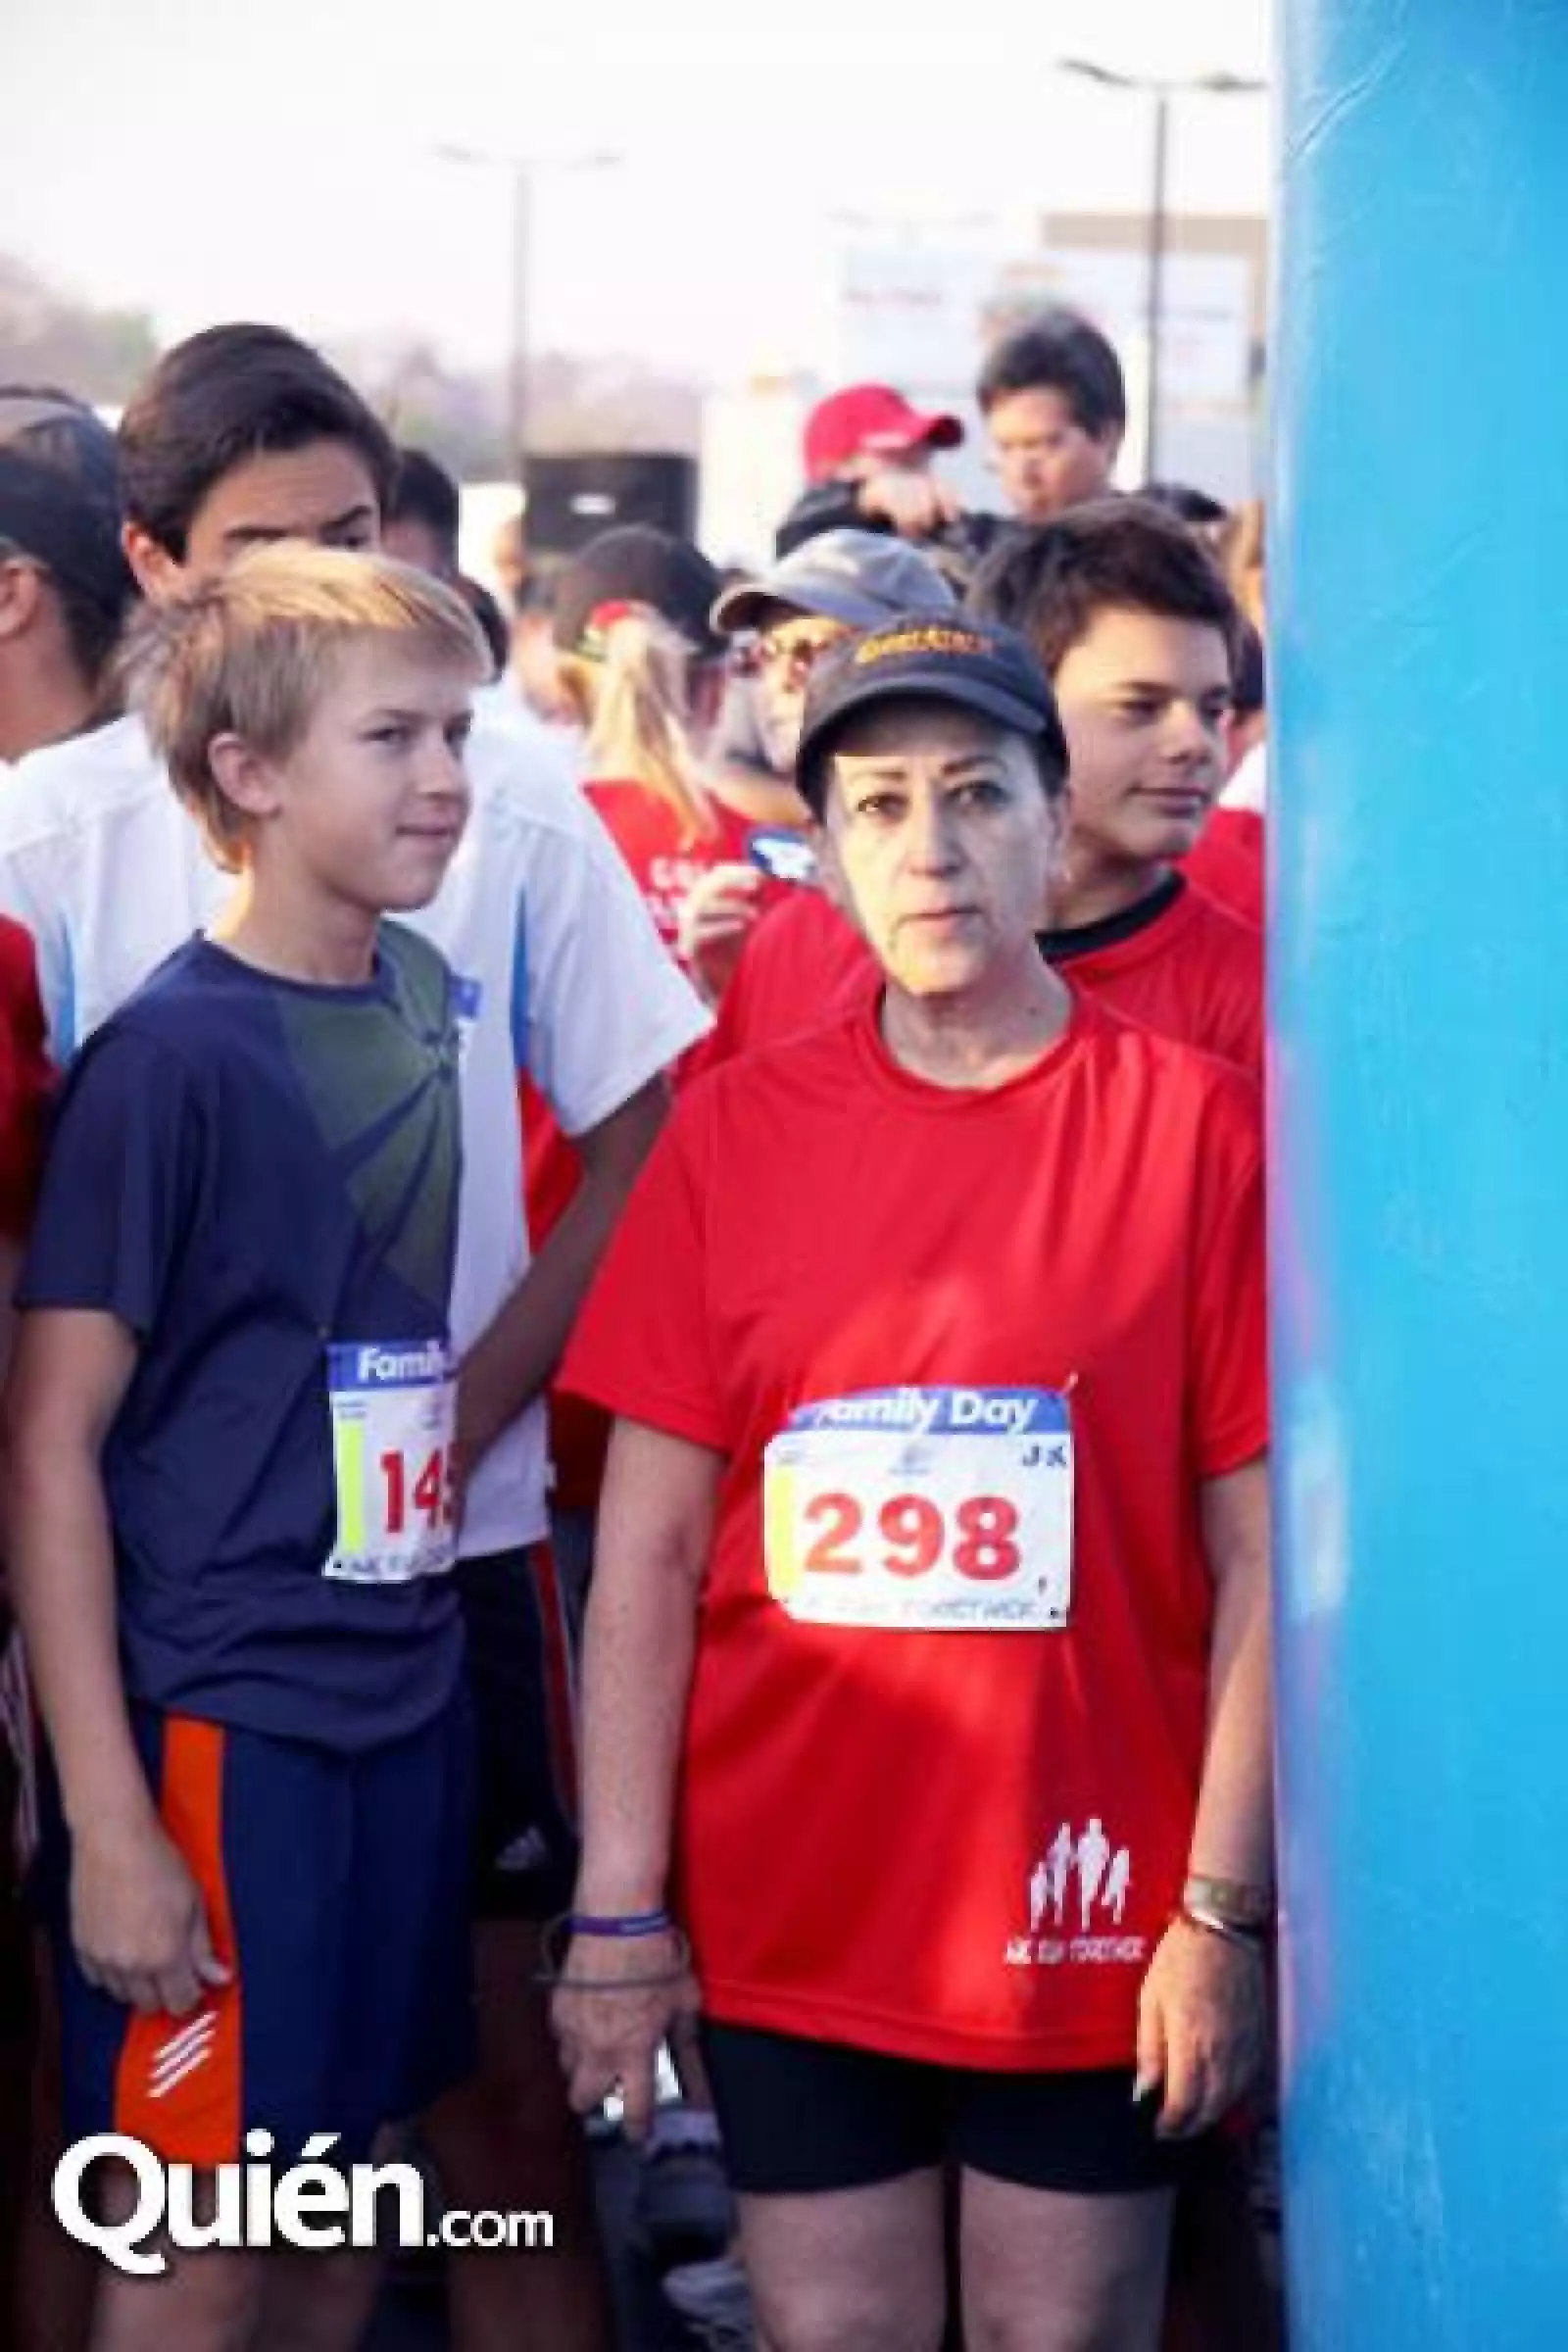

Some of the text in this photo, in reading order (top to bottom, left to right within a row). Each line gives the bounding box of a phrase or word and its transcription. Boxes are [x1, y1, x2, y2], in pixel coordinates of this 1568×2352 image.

[950, 1390, 1039, 1434] Day
[379, 1447, 454, 1534] 14
[803, 1492, 1022, 1581] 298
